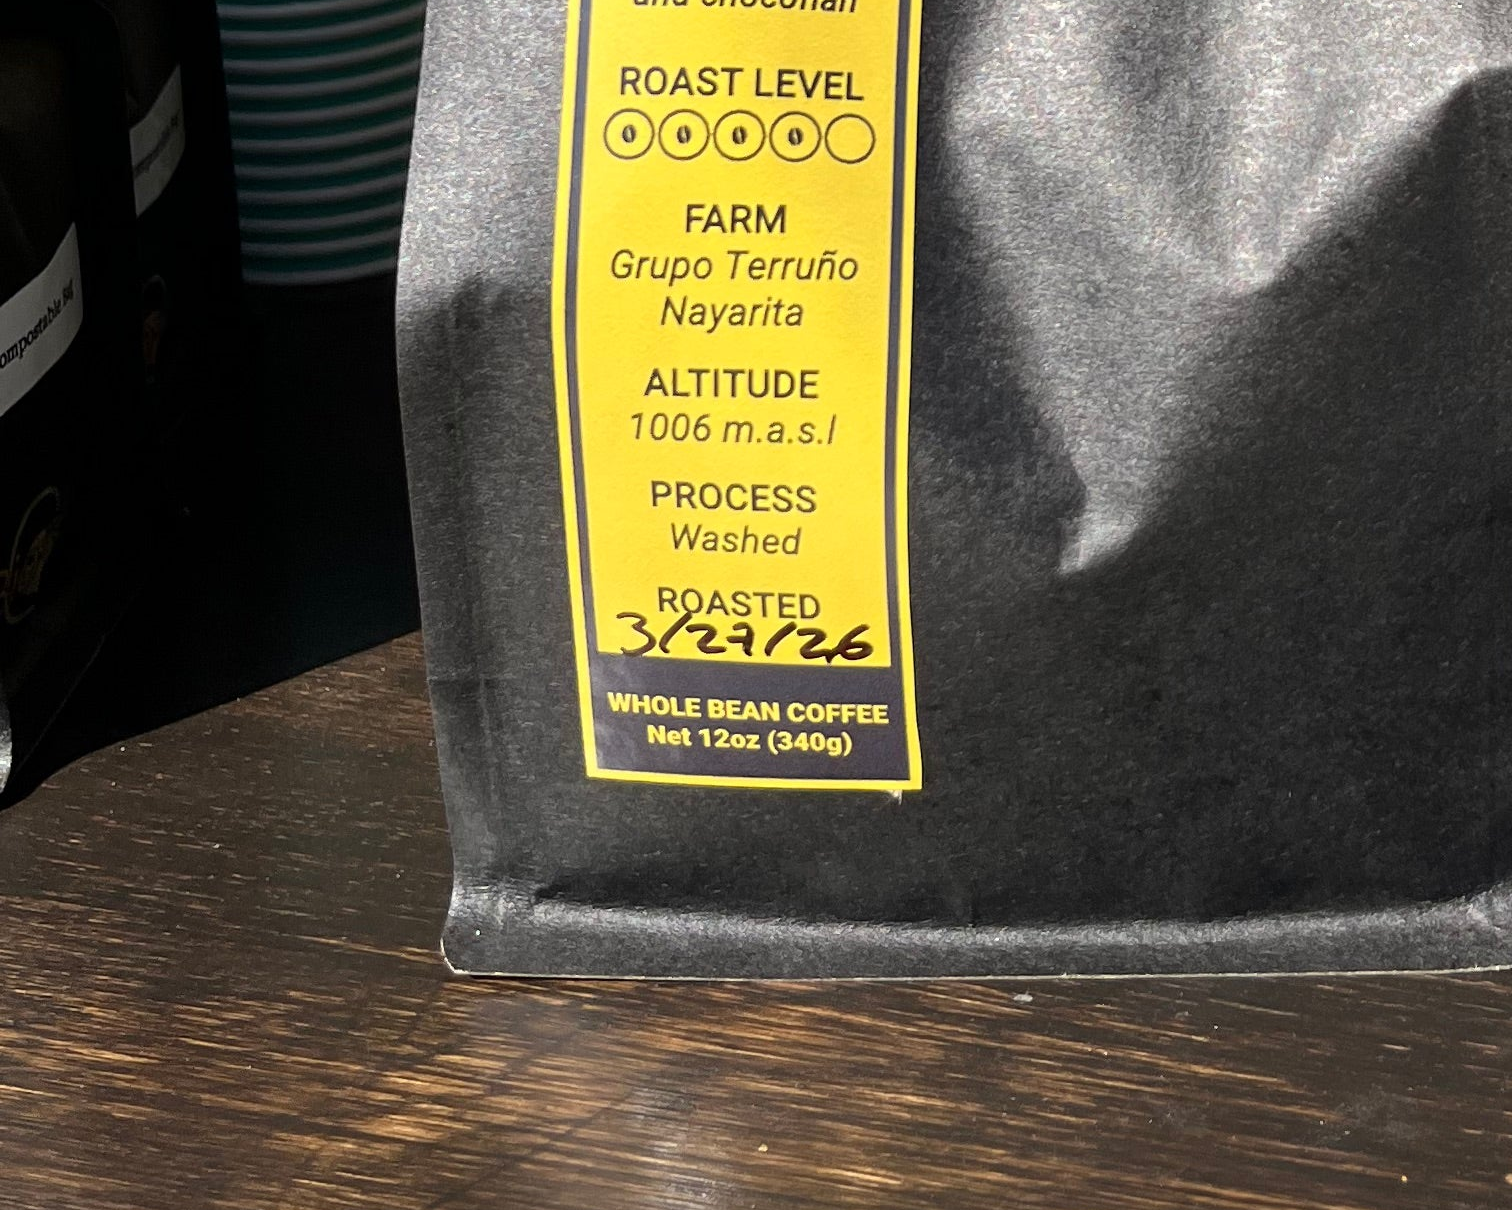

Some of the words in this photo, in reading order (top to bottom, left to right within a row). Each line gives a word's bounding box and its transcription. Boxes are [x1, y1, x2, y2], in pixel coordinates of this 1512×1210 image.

[620, 66, 744, 96] ROAST
[754, 67, 864, 101] LEVEL
[684, 203, 786, 234] FARM
[610, 249, 713, 287] Grupo
[727, 250, 859, 281] Terruño
[660, 295, 804, 334] Nayarita
[0, 298, 61, 368] ompostable
[643, 367, 820, 399] ALTITUDE
[630, 412, 711, 442] 1006
[721, 413, 837, 445] m.a.s.l
[651, 480, 818, 513] PROCESS
[670, 522, 803, 555] Washed
[657, 586, 821, 619] ROASTED
[616, 611, 874, 664] 3/27/26
[607, 691, 702, 718] WHOLE
[707, 698, 781, 722] BEAN
[786, 702, 889, 725] COFFEE
[647, 724, 692, 747] Net
[697, 726, 761, 751] 12oz
[767, 729, 852, 756] (340g)
